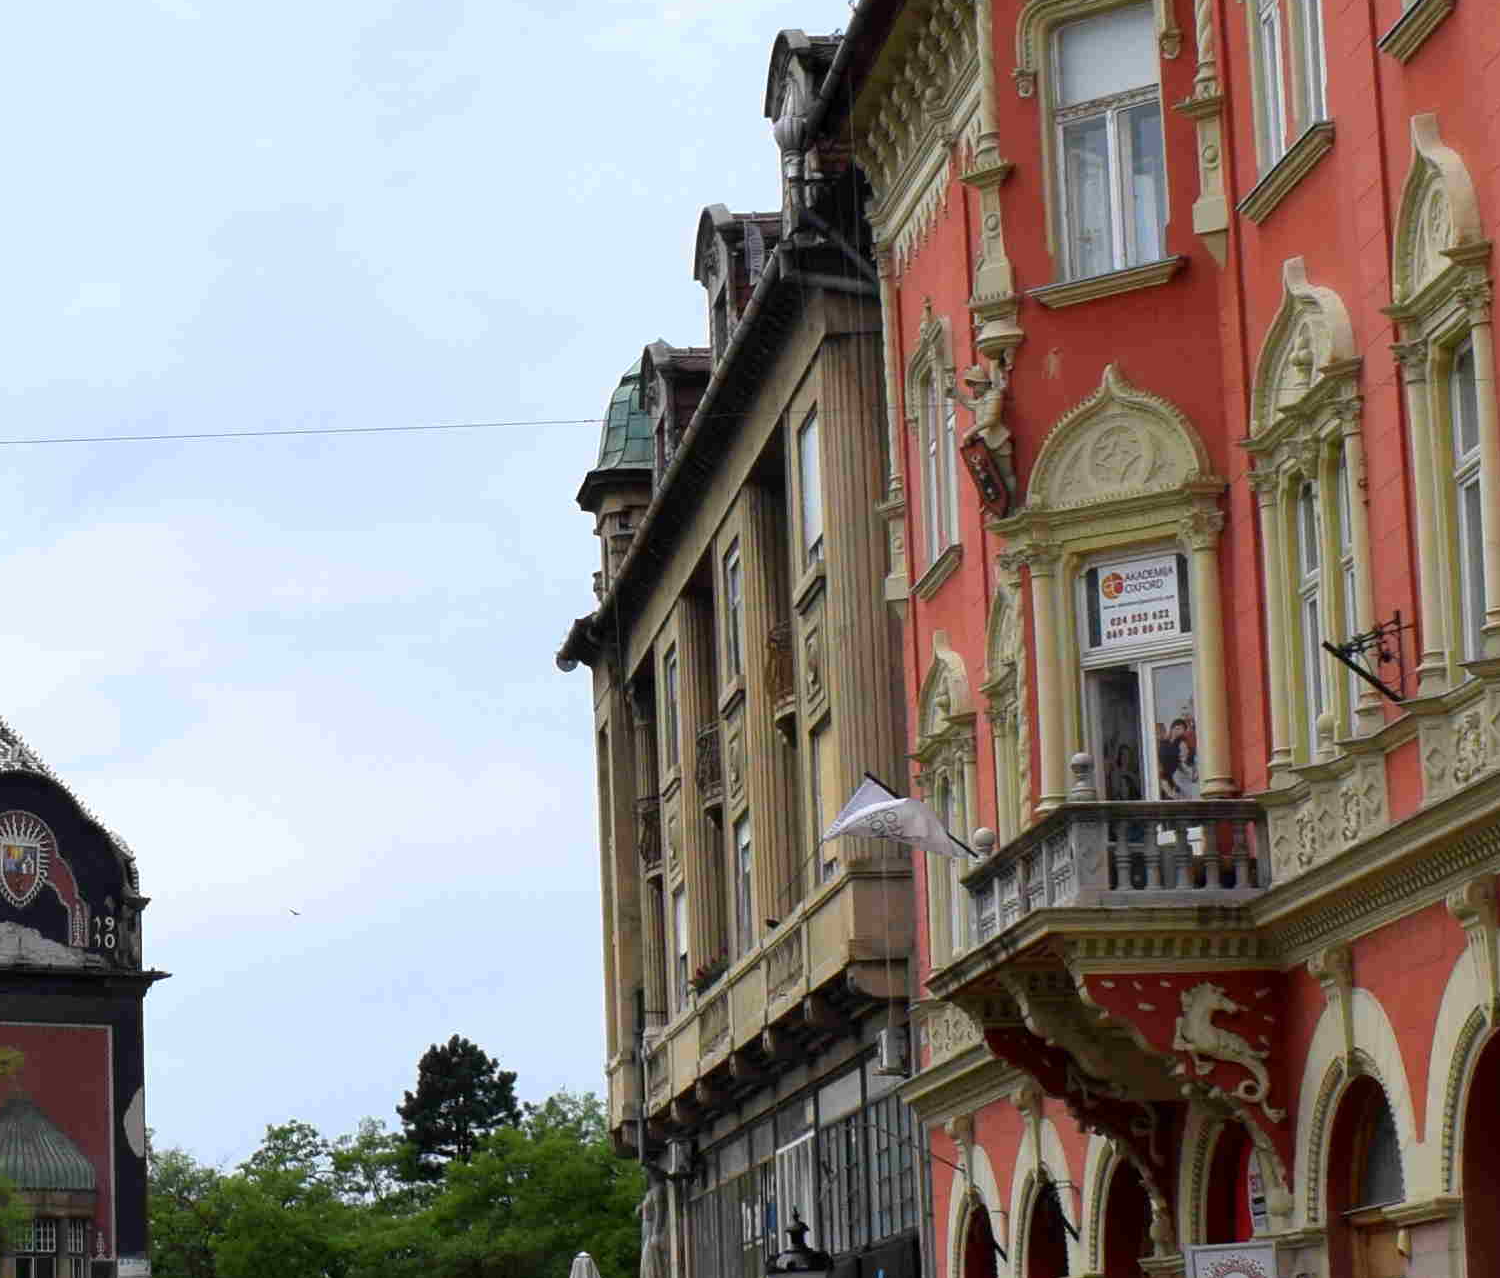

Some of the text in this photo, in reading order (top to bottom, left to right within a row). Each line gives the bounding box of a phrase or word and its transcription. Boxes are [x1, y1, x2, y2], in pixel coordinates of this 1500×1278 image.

[1124, 578, 1164, 594] OXFORD
[94, 916, 115, 932] 19
[94, 934, 116, 949] 10
